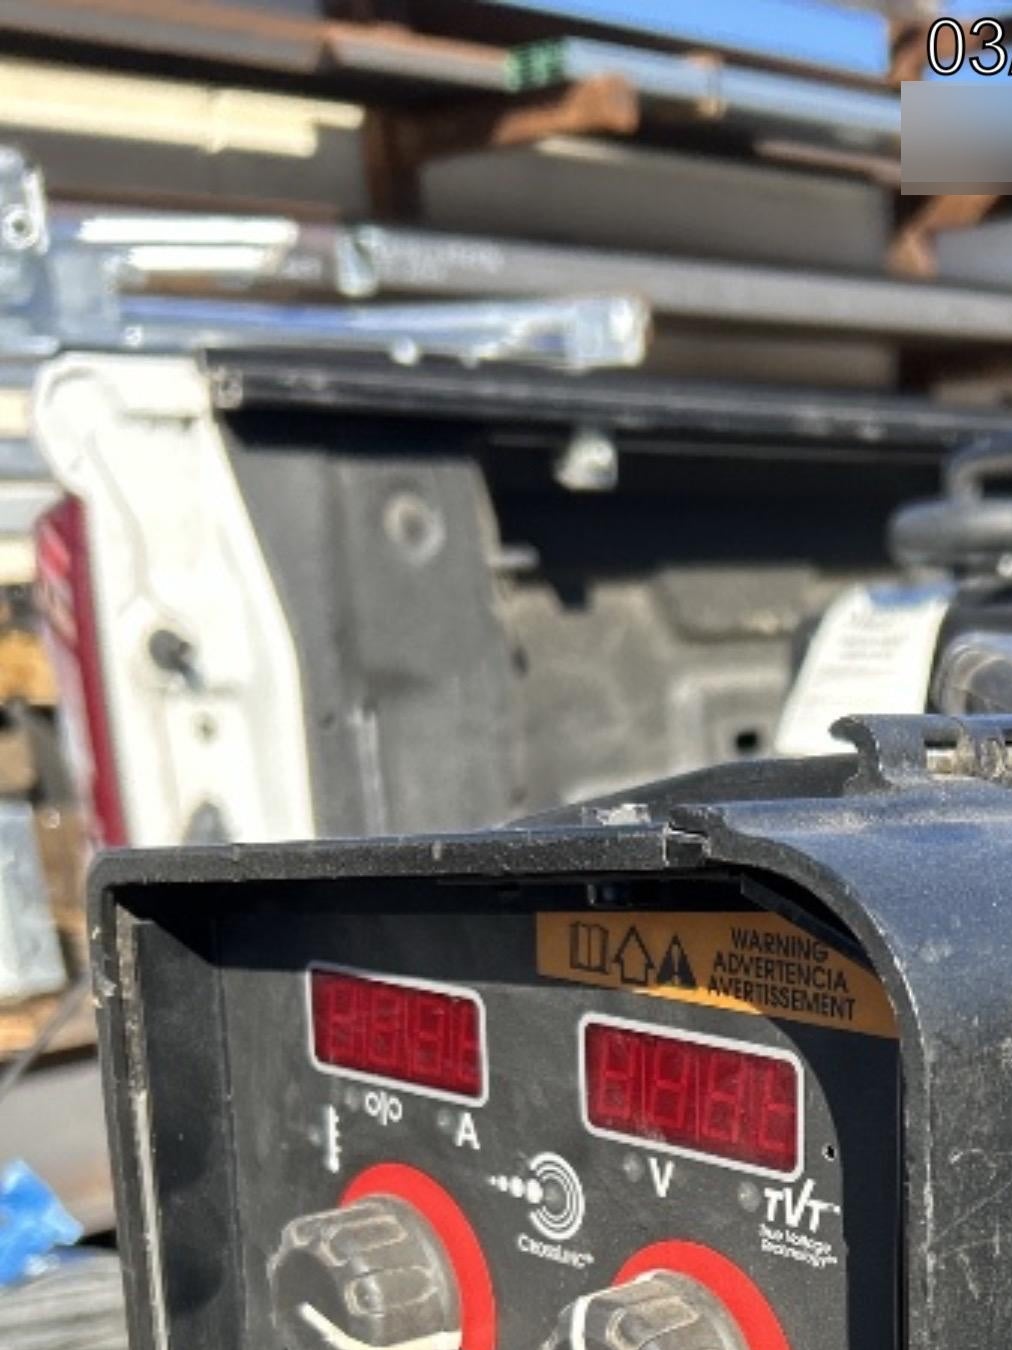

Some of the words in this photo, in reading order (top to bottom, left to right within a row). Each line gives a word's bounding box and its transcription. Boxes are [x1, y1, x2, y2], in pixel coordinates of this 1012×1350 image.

[731, 926, 828, 963] WARNING
[713, 951, 848, 993] ADVERTENCIA
[708, 973, 856, 1021] AVERTISSEMENT
[455, 1112, 480, 1150] A
[649, 1156, 675, 1198] V
